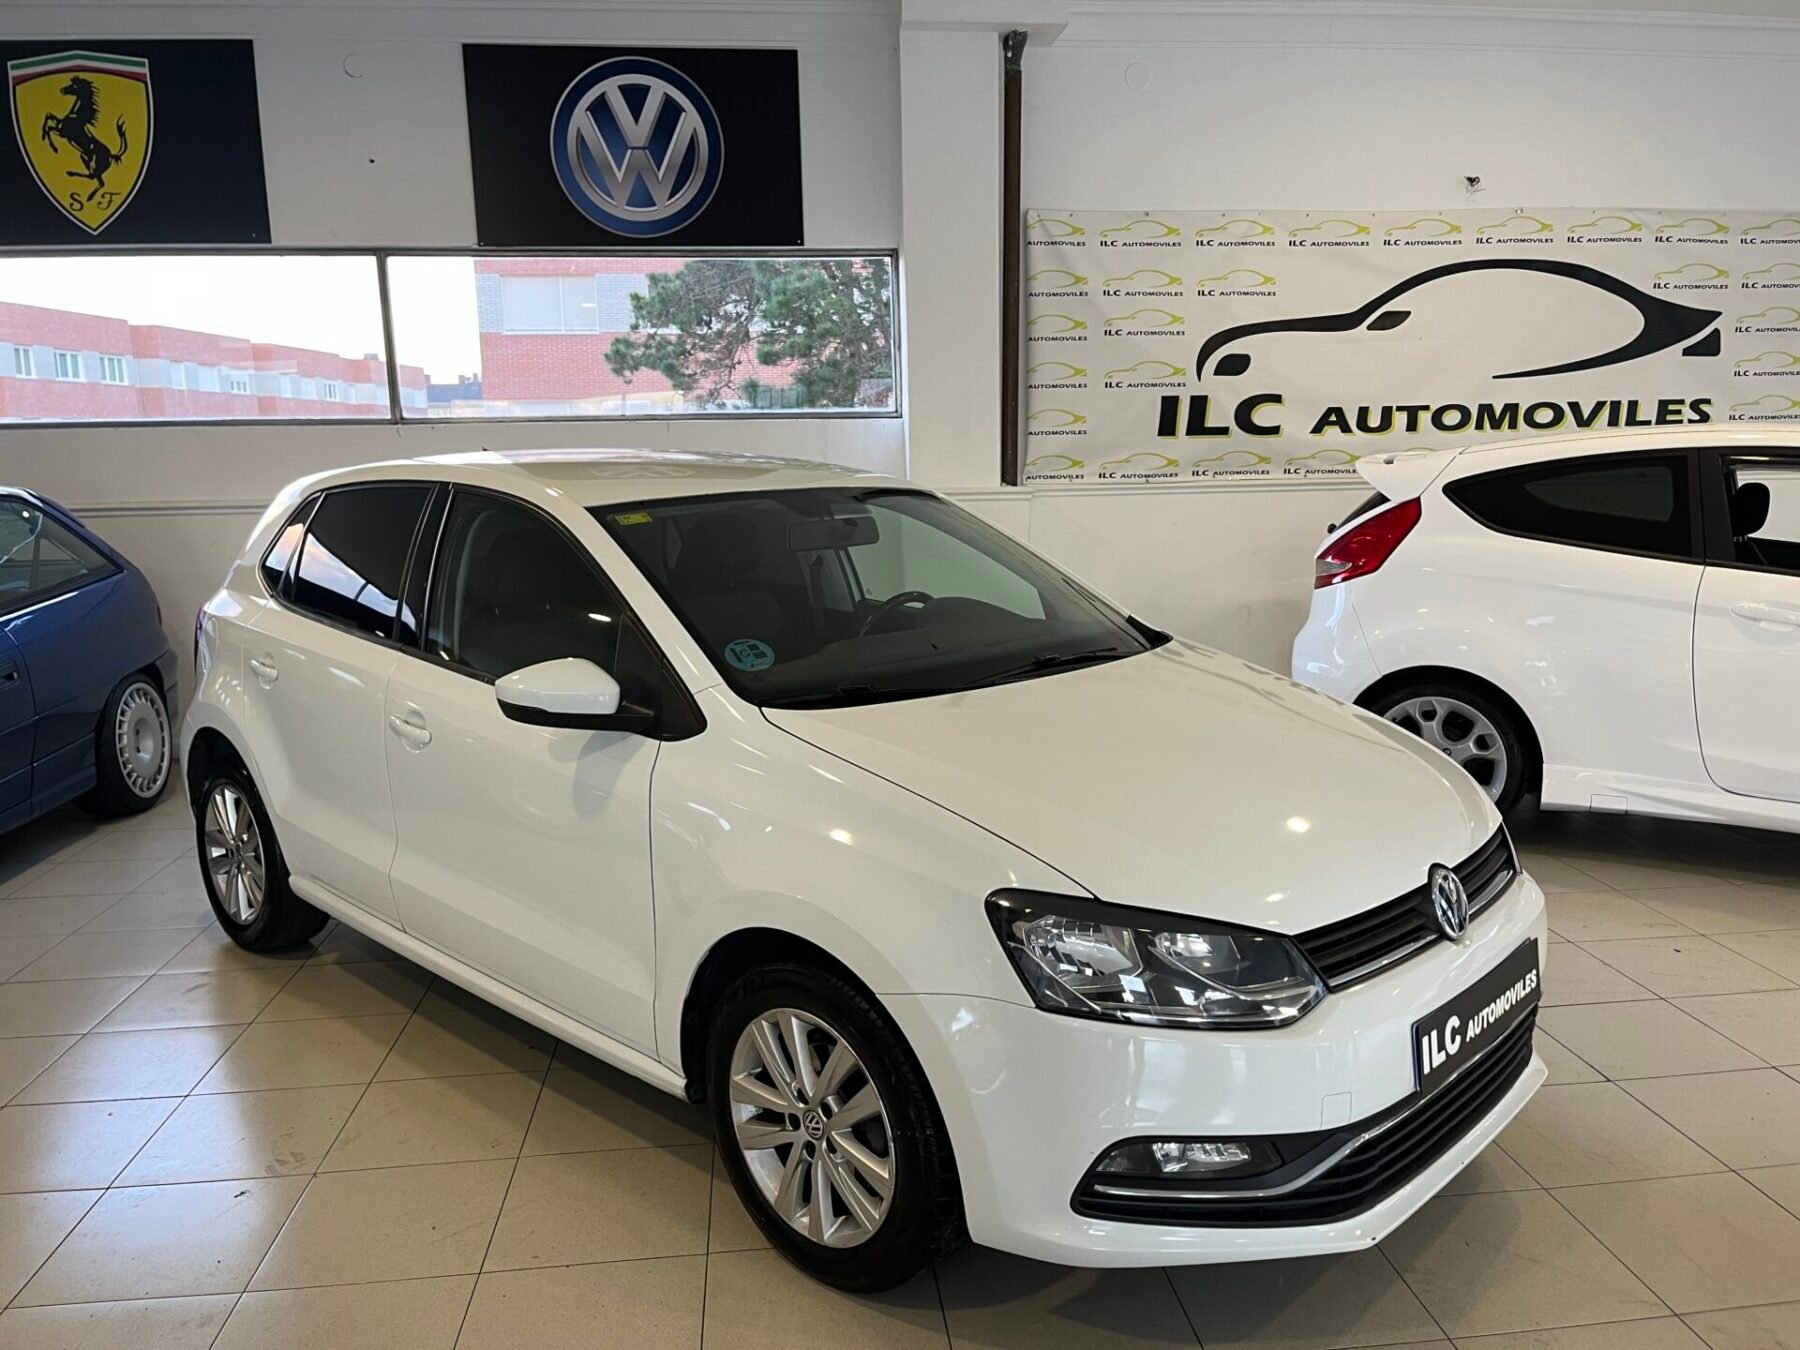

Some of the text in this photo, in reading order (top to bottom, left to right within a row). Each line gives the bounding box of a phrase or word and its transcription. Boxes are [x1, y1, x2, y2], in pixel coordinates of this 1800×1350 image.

[1195, 239, 1214, 247] ILC
[1288, 239, 1307, 247] ILC
[1475, 236, 1493, 244] ILC
[1567, 235, 1585, 243] ILC
[1654, 235, 1728, 245] ILC AUTOMOVILES
[1740, 237, 1757, 245] ILC
[1653, 282, 1670, 290] ILC
[1102, 289, 1121, 297] ILC
[1197, 289, 1215, 297] ILC
[1103, 328, 1123, 337] ILC
[1104, 381, 1124, 389] ILC
[1157, 393, 1713, 438] ILC AUTOMOVILES
[1728, 413, 1745, 421] ILC
[1191, 469, 1209, 477] ILC
[1283, 467, 1302, 475] ILC
[1026, 473, 1085, 481] AUTOMOVILES
[1421, 967, 1538, 1075] ILC AUTOMOVILES
